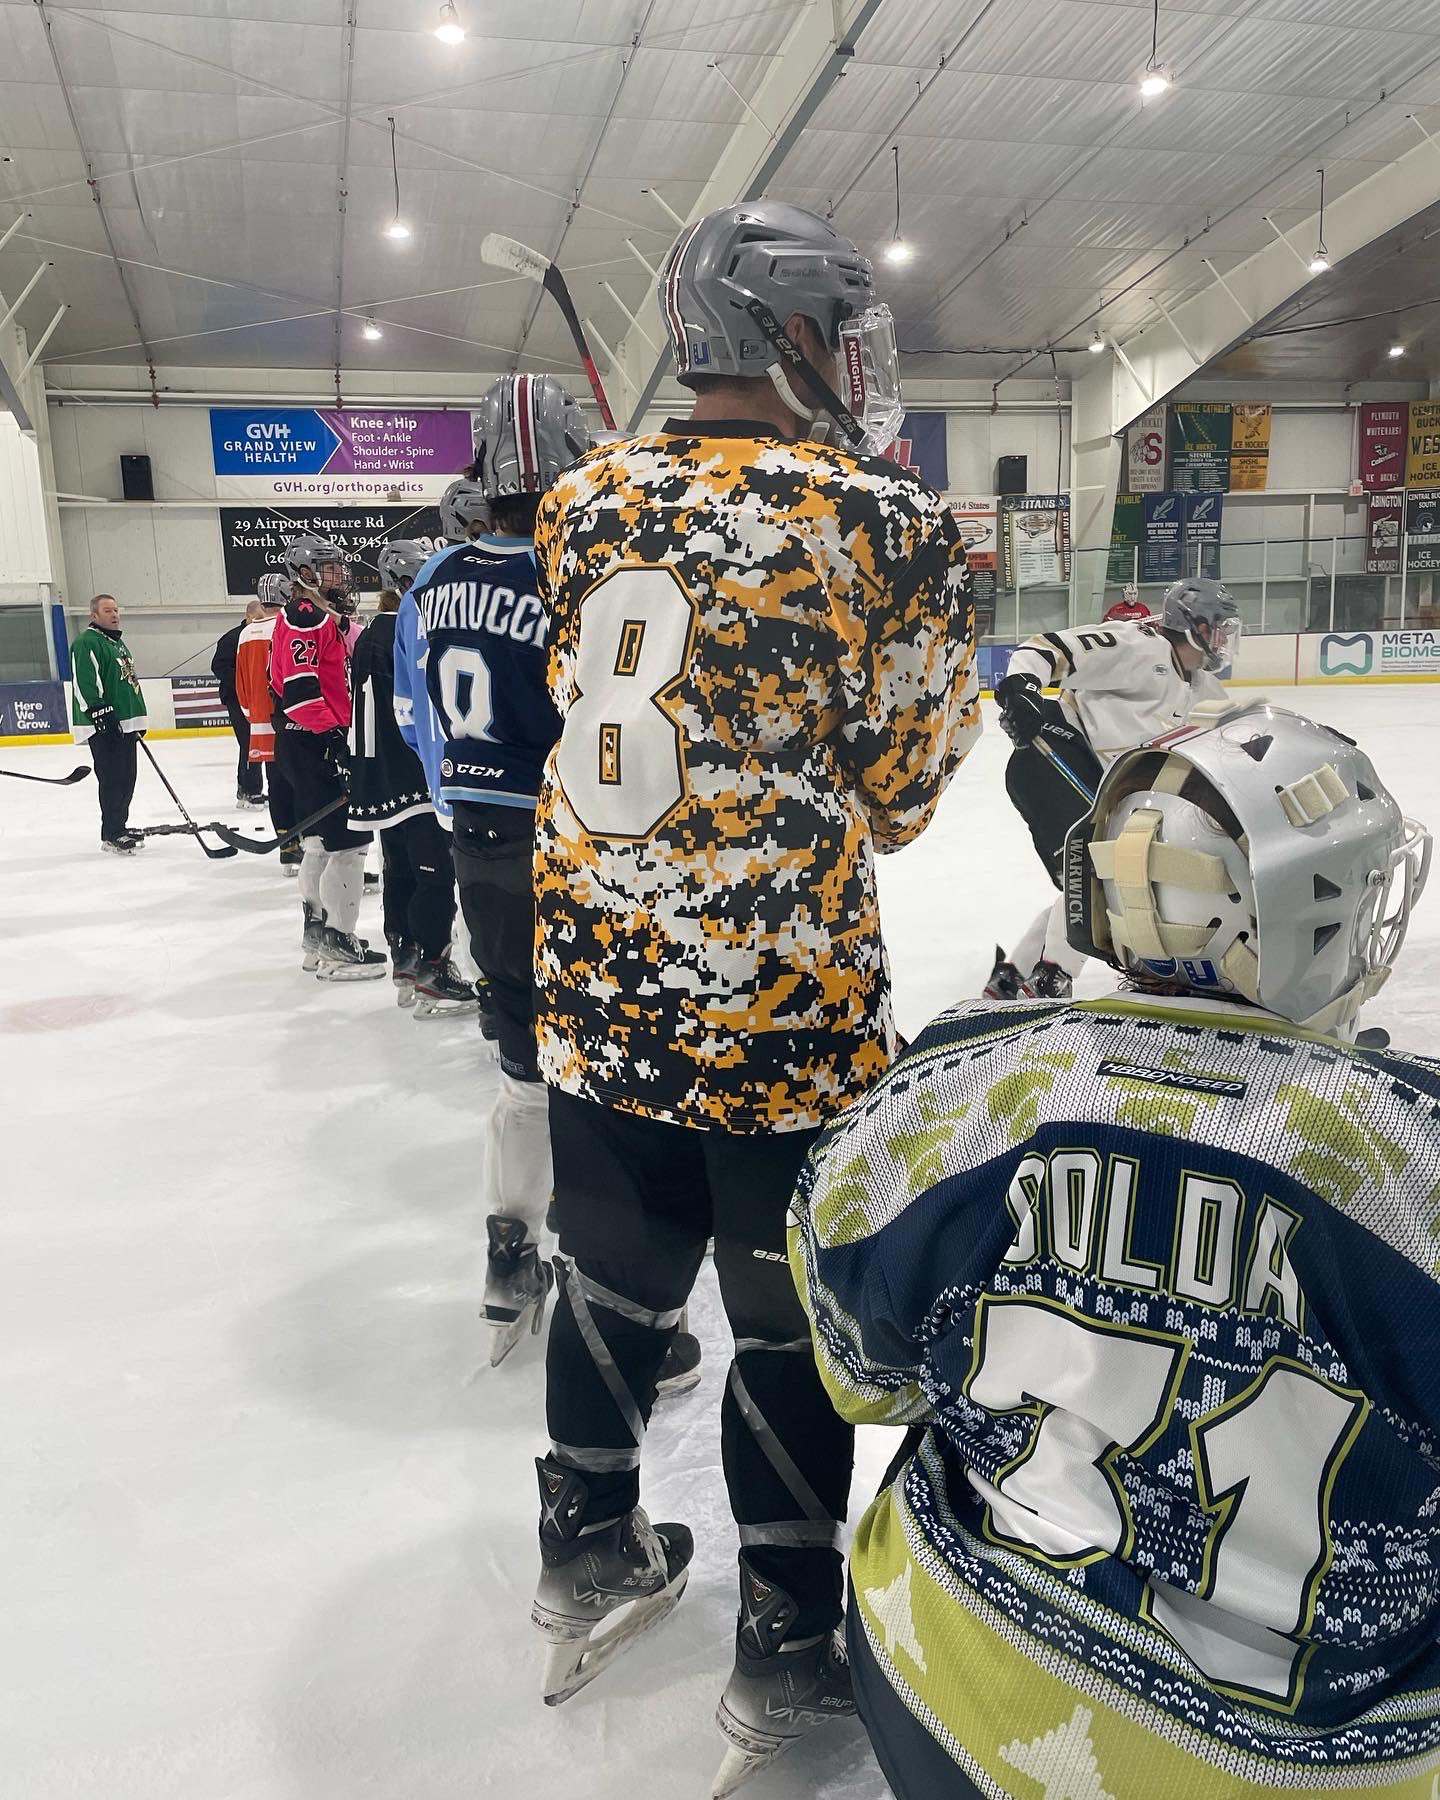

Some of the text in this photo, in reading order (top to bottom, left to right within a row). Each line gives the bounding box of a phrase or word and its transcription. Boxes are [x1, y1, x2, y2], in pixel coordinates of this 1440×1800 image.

[848, 340, 863, 402] KNIGHTS
[1371, 411, 1400, 421] PLYMOUTH
[350, 417, 418, 431] Knee Hip
[246, 423, 292, 440] GVH
[351, 432, 412, 443] Foot Ankle
[223, 441, 317, 452] GRAND VIEW
[1233, 441, 1269, 449] ICE HOCKEY
[244, 452, 297, 463] HEALTH
[352, 446, 435, 459] Shoulder Spine
[353, 459, 415, 470] Hand Wrist
[1422, 462, 1438, 472] ICE
[1365, 473, 1399, 483] ICE HOCKEY
[273, 481, 424, 495] GVH.org/orthopaedics
[1116, 496, 1142, 505] ATHOLIC
[1370, 495, 1403, 508] ABINGTON
[1408, 493, 1430, 501] CENTRAL
[949, 501, 990, 511] 2014 States
[1020, 499, 1056, 509] TITANS
[1418, 501, 1437, 509] SOUTH
[234, 520, 251, 532] 29
[254, 516, 310, 533] Airport
[313, 516, 362, 532] Square
[365, 515, 386, 528] Rd
[231, 535, 277, 548] North
[329, 534, 348, 546] PA
[352, 536, 390, 548] 19454
[1062, 538, 1071, 573] DIVISION
[1418, 551, 1432, 560] ICE
[1003, 535, 1013, 588] CHAMPIONS
[1407, 560, 1440, 569] HOCKEY
[1076, 631, 1117, 651] 2
[1382, 632, 1435, 645] META
[289, 638, 320, 668] 27
[14, 701, 43, 711] Here
[554, 561, 700, 844] 8
[15, 710, 36, 720] We
[17, 720, 51, 730] Grow.
[202, 718, 231, 727] MODERN
[1042, 722, 1075, 740] UER
[456, 763, 505, 778] CCM
[1067, 837, 1084, 927] WARWICK
[962, 1292, 1372, 1717] 71
